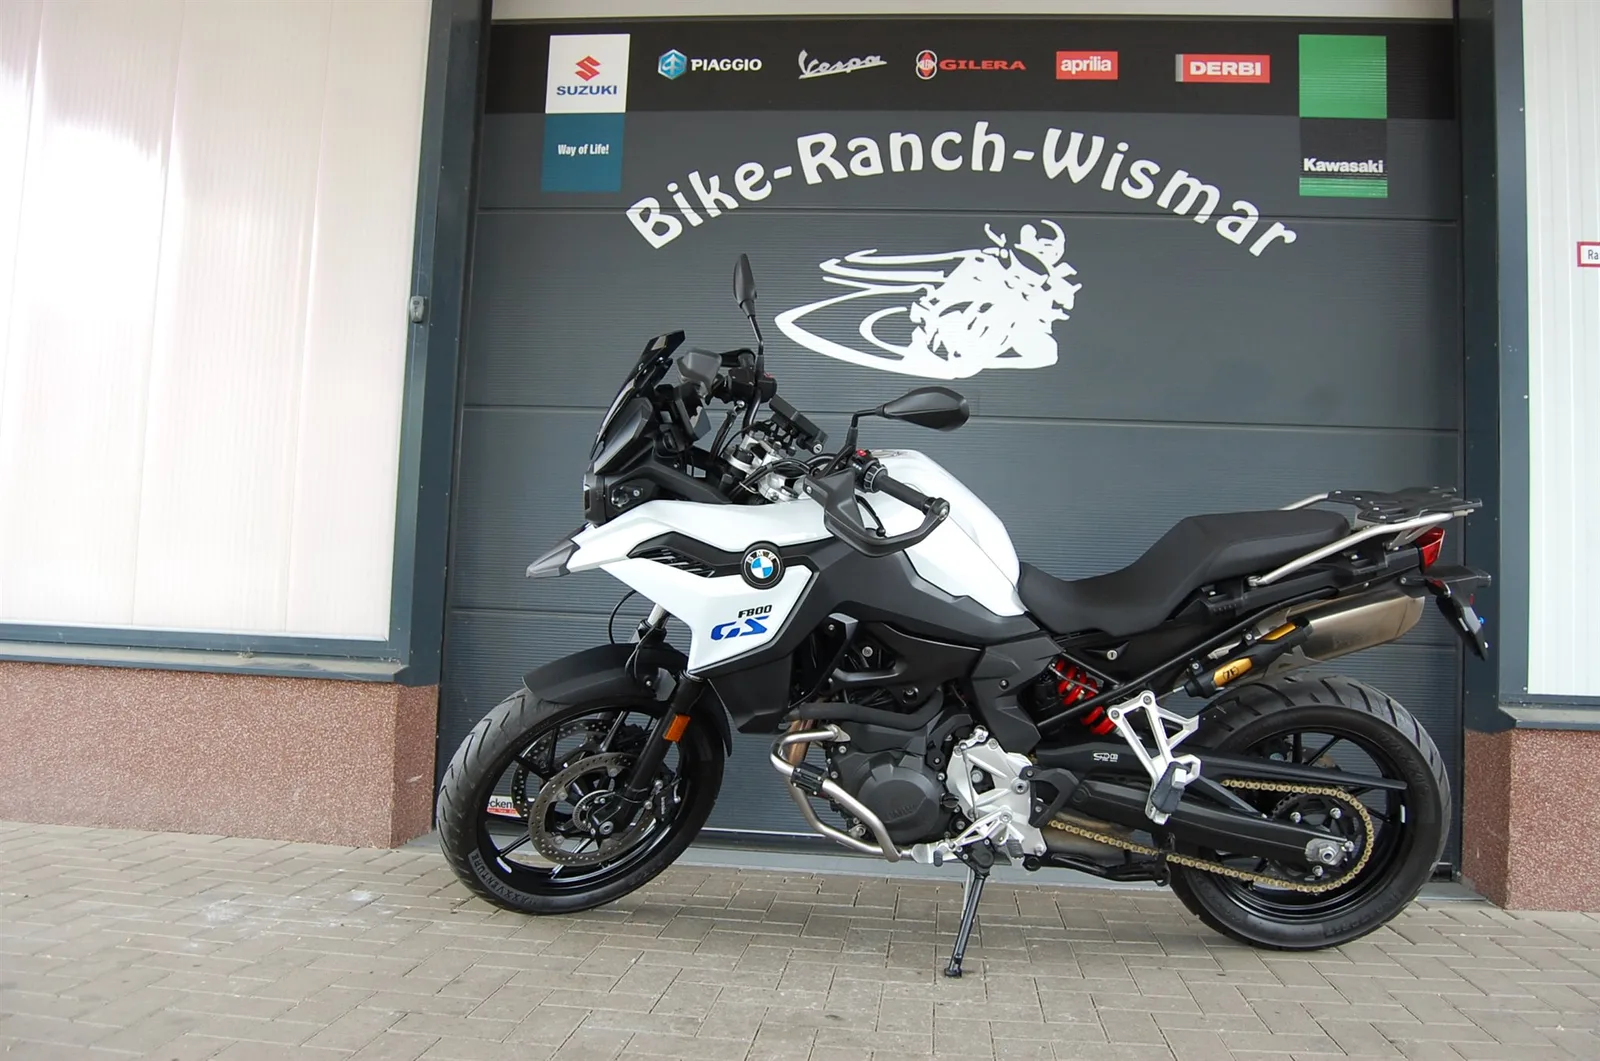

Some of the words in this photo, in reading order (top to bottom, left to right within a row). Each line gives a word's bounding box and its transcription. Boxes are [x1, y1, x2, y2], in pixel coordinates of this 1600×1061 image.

[690, 58, 763, 72] PIAGGIO
[798, 49, 888, 79] Vespa
[939, 58, 1027, 71] GILERA
[1060, 55, 1112, 75] aprilia
[1189, 61, 1262, 77] DERBI
[556, 84, 618, 96] SUZUKI
[558, 144, 577, 157] Way
[578, 143, 589, 155] of
[589, 143, 610, 155] Life!
[1303, 157, 1384, 174] Kawasaki
[626, 121, 1297, 257] Bike-Ranch-Wismar
[738, 604, 773, 619] F800
[711, 615, 769, 641] GS
